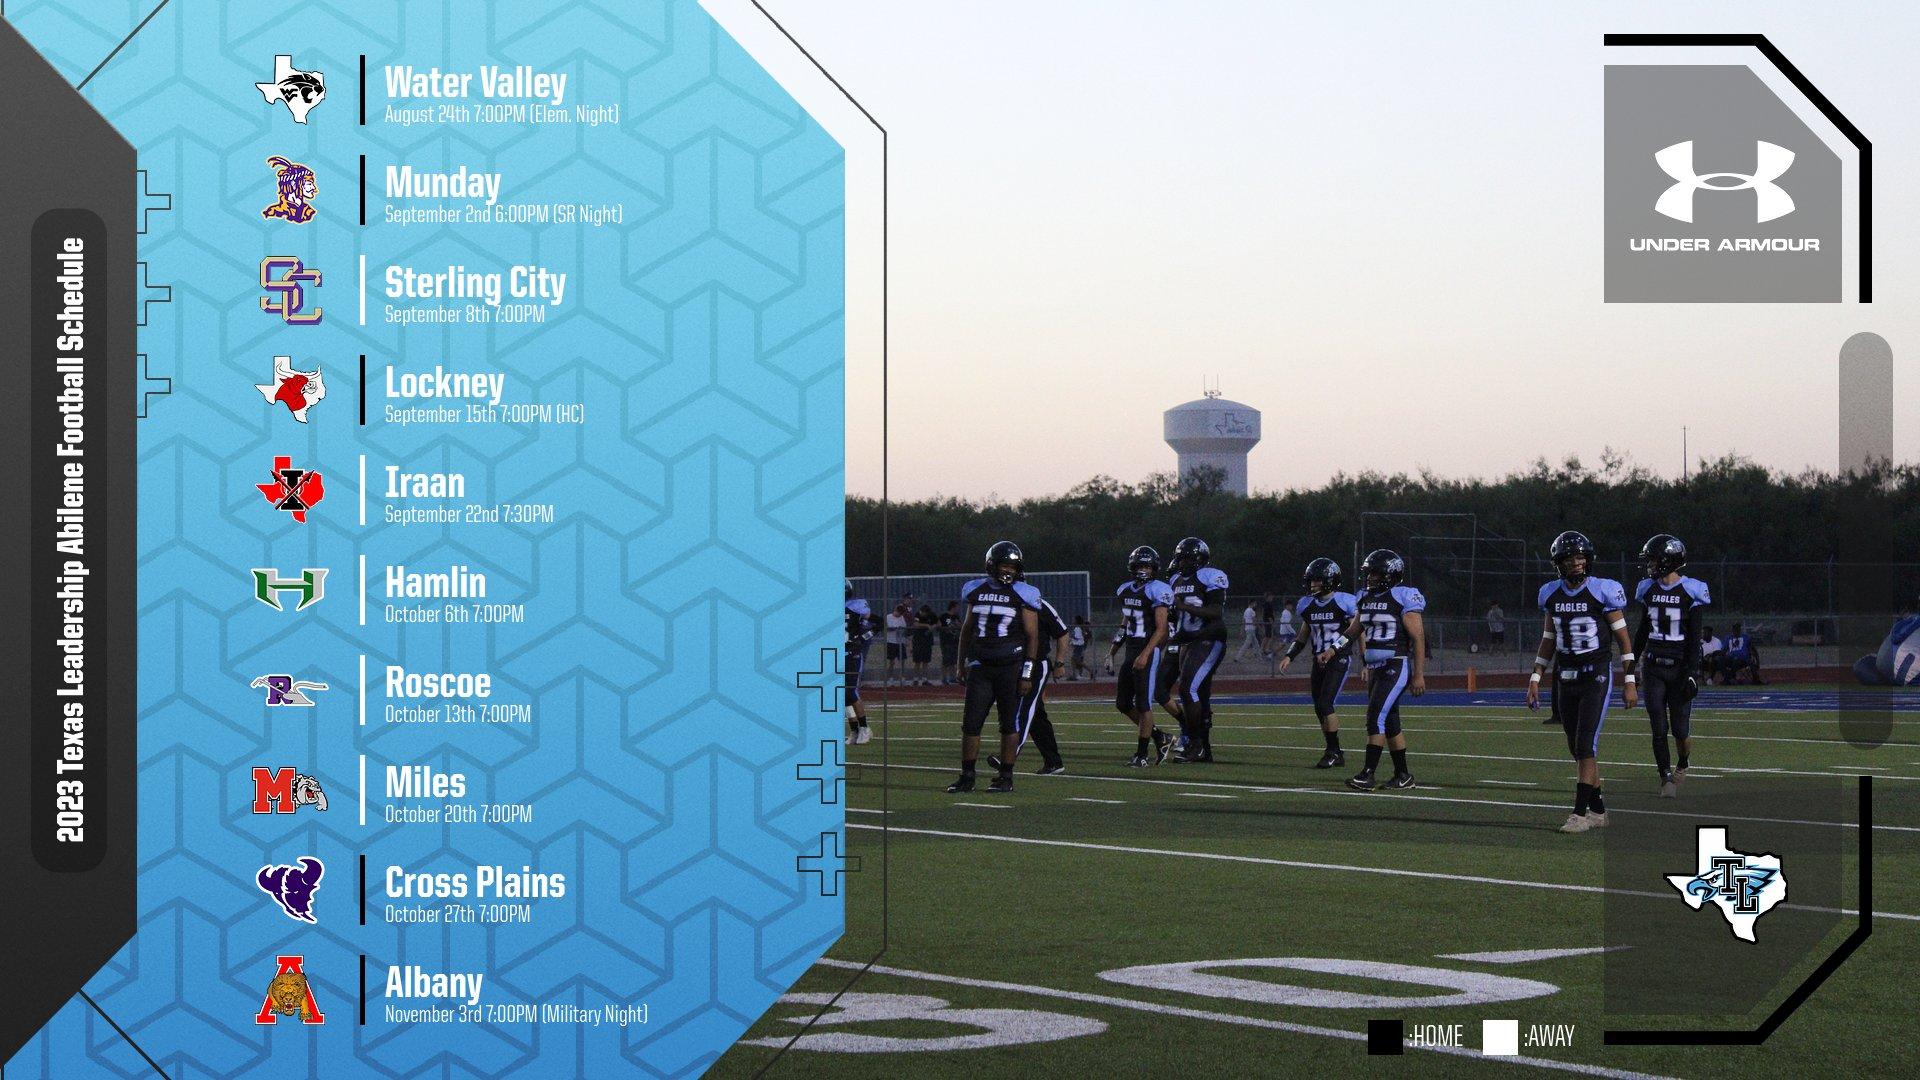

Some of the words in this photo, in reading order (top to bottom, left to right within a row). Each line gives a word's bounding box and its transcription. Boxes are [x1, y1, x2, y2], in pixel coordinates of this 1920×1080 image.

[978, 593, 1010, 603] EAGLES
[1124, 598, 1142, 606] EAGLES
[1652, 594, 1680, 604] EAGLES
[1555, 603, 1587, 612] EAGLES
[972, 605, 1016, 638] 77
[1310, 612, 1334, 621] EAGLES
[1648, 607, 1685, 641] 11
[1552, 616, 1599, 655] 18
